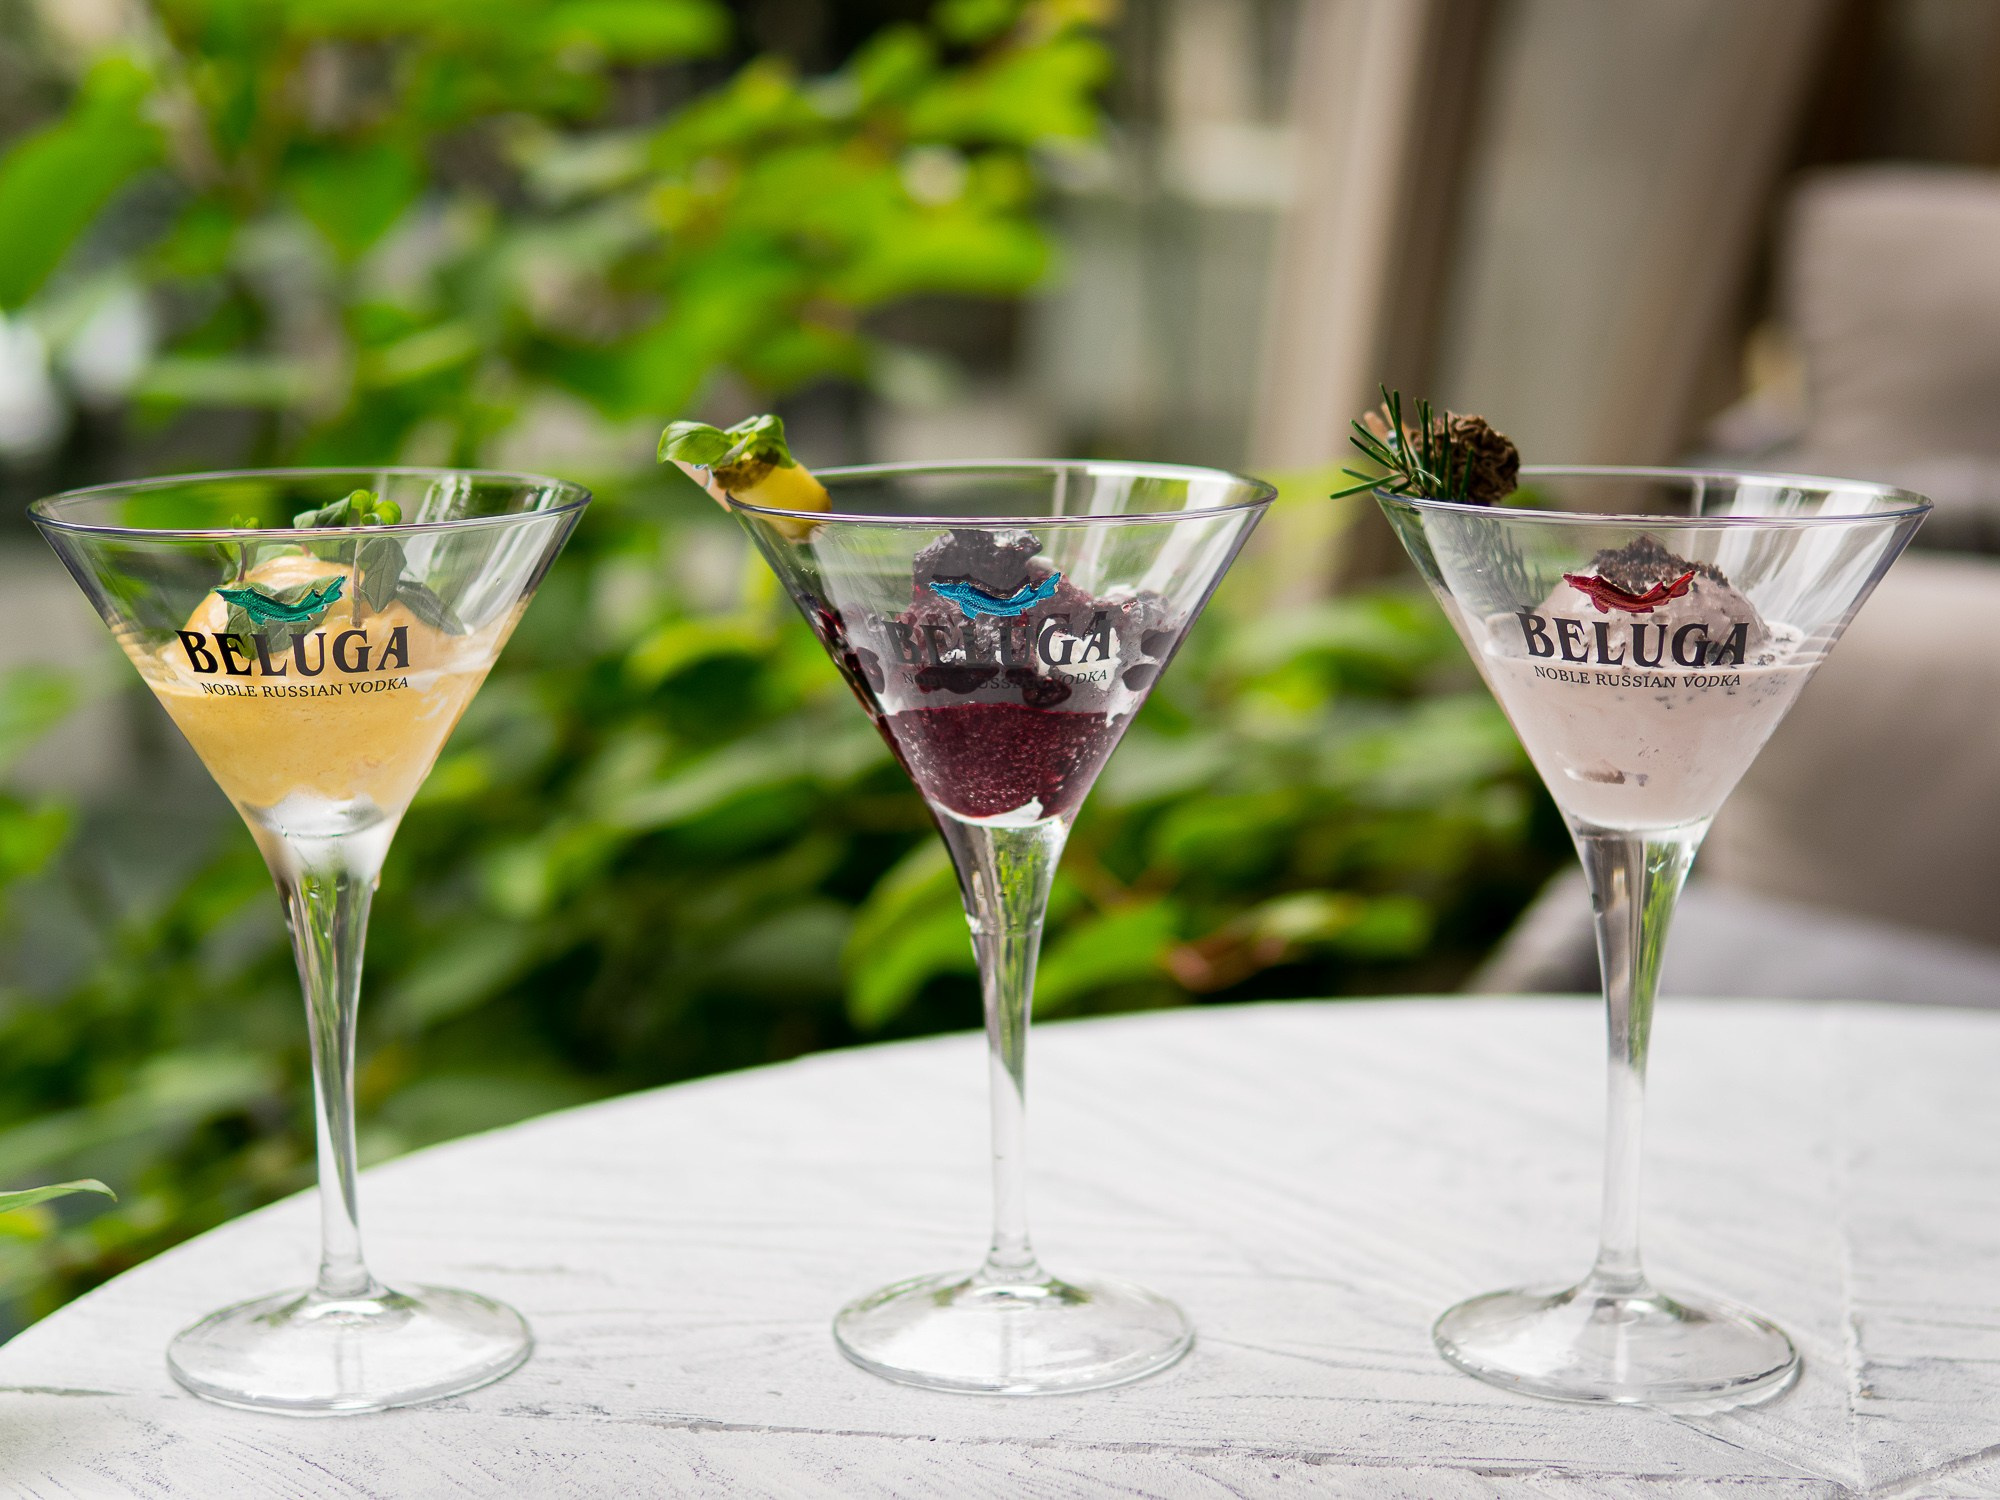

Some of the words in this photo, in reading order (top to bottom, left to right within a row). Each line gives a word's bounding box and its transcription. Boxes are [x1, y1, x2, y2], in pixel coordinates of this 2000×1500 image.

[174, 625, 410, 677] BELUGA
[880, 620, 1112, 668] BELUGA
[1515, 612, 1750, 667] BELUGA
[201, 682, 258, 697] NOBLE
[263, 685, 343, 698] RUSSIAN
[348, 676, 409, 694] VODKA
[1534, 665, 1591, 684] NOBLE
[1596, 673, 1677, 688] RUSSIAN
[1682, 674, 1741, 688] VODKA
